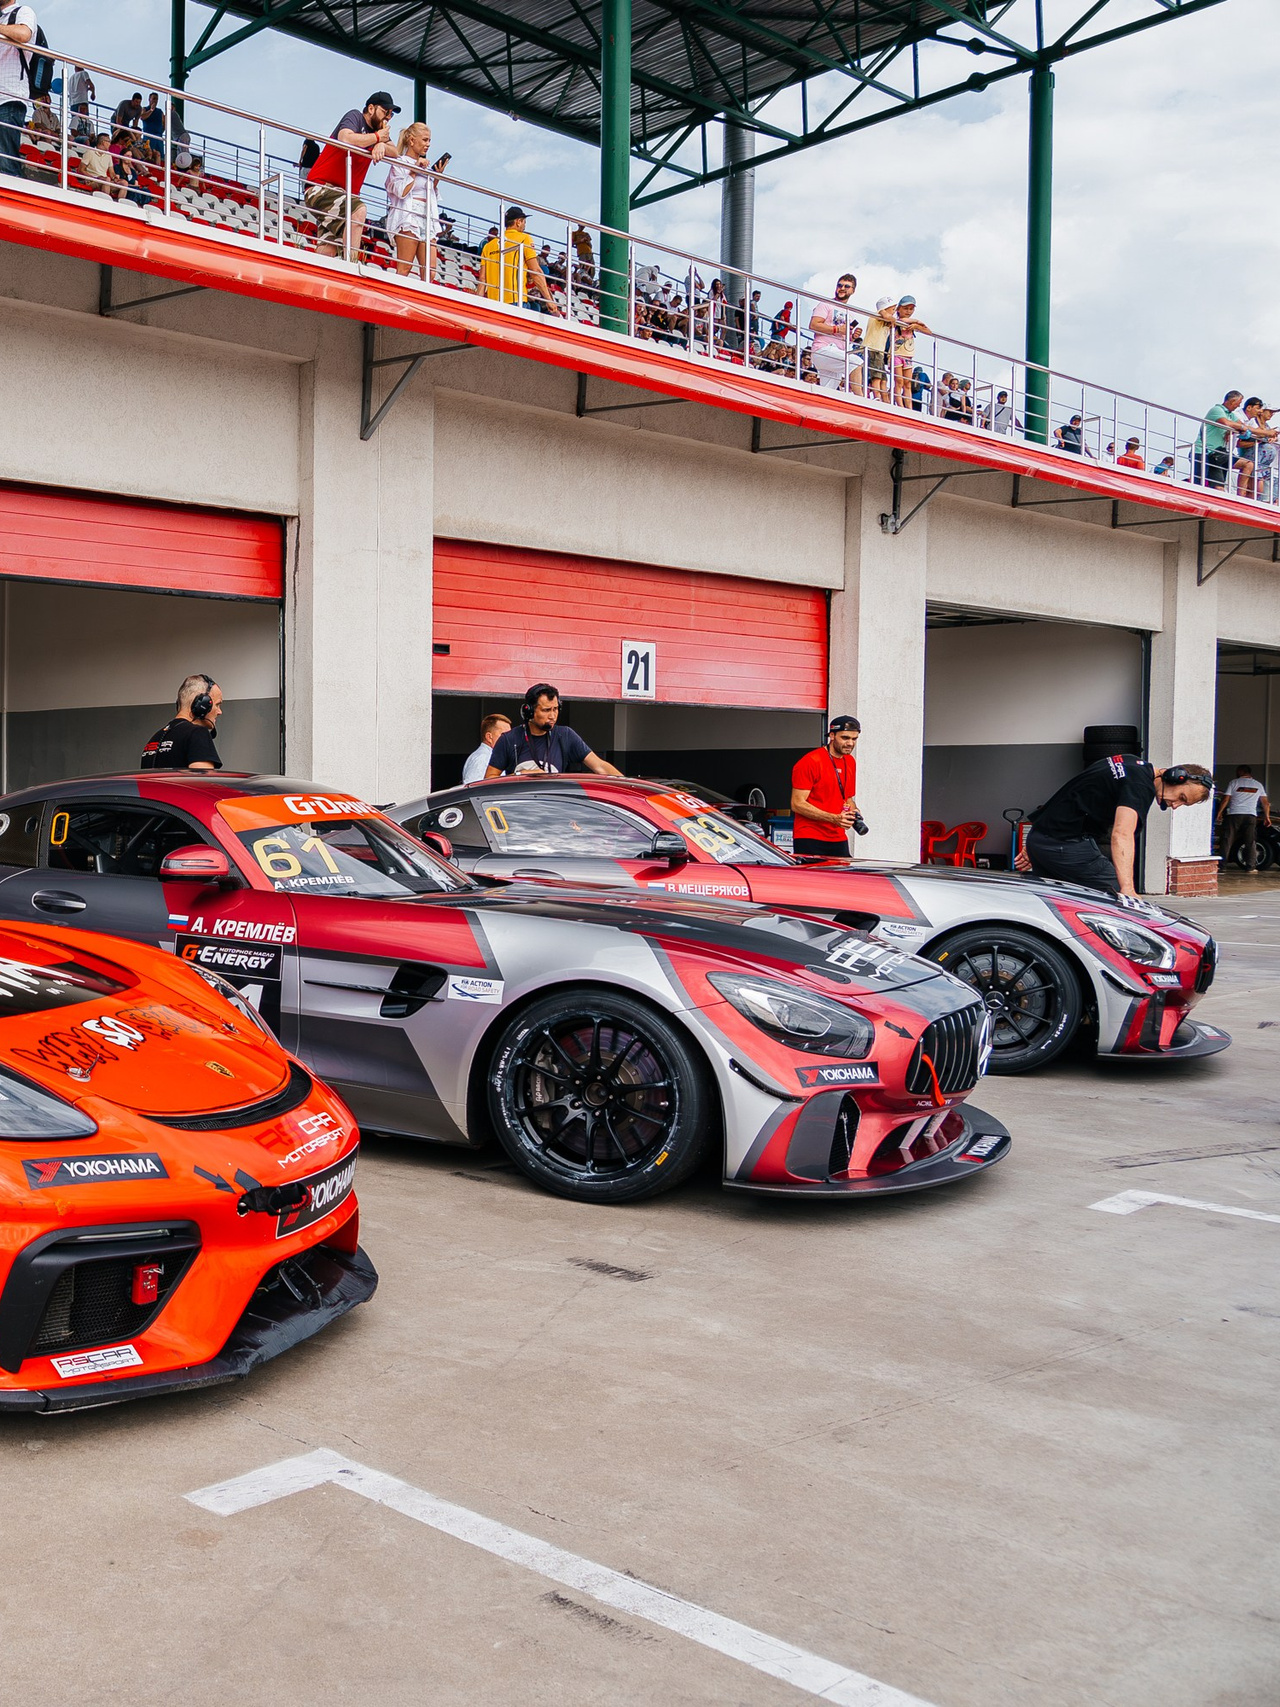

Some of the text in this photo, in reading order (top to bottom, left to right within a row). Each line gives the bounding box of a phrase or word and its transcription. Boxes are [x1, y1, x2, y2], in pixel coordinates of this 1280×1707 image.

[627, 650, 650, 691] 21
[681, 817, 736, 853] 63
[253, 837, 341, 878] 61
[290, 875, 355, 888] КРЕМЛЁВ
[191, 917, 296, 943] А. КРЕМЛЁВ
[470, 980, 492, 988] ACTION
[82, 1015, 147, 1051] SO
[819, 1066, 874, 1081] YOKOHAMA
[277, 1127, 346, 1169] MOTORSPORT
[63, 1158, 160, 1178] YOKOHAMA
[56, 1347, 133, 1368] RSCAR
[62, 1357, 136, 1375] MOTORSPORT
